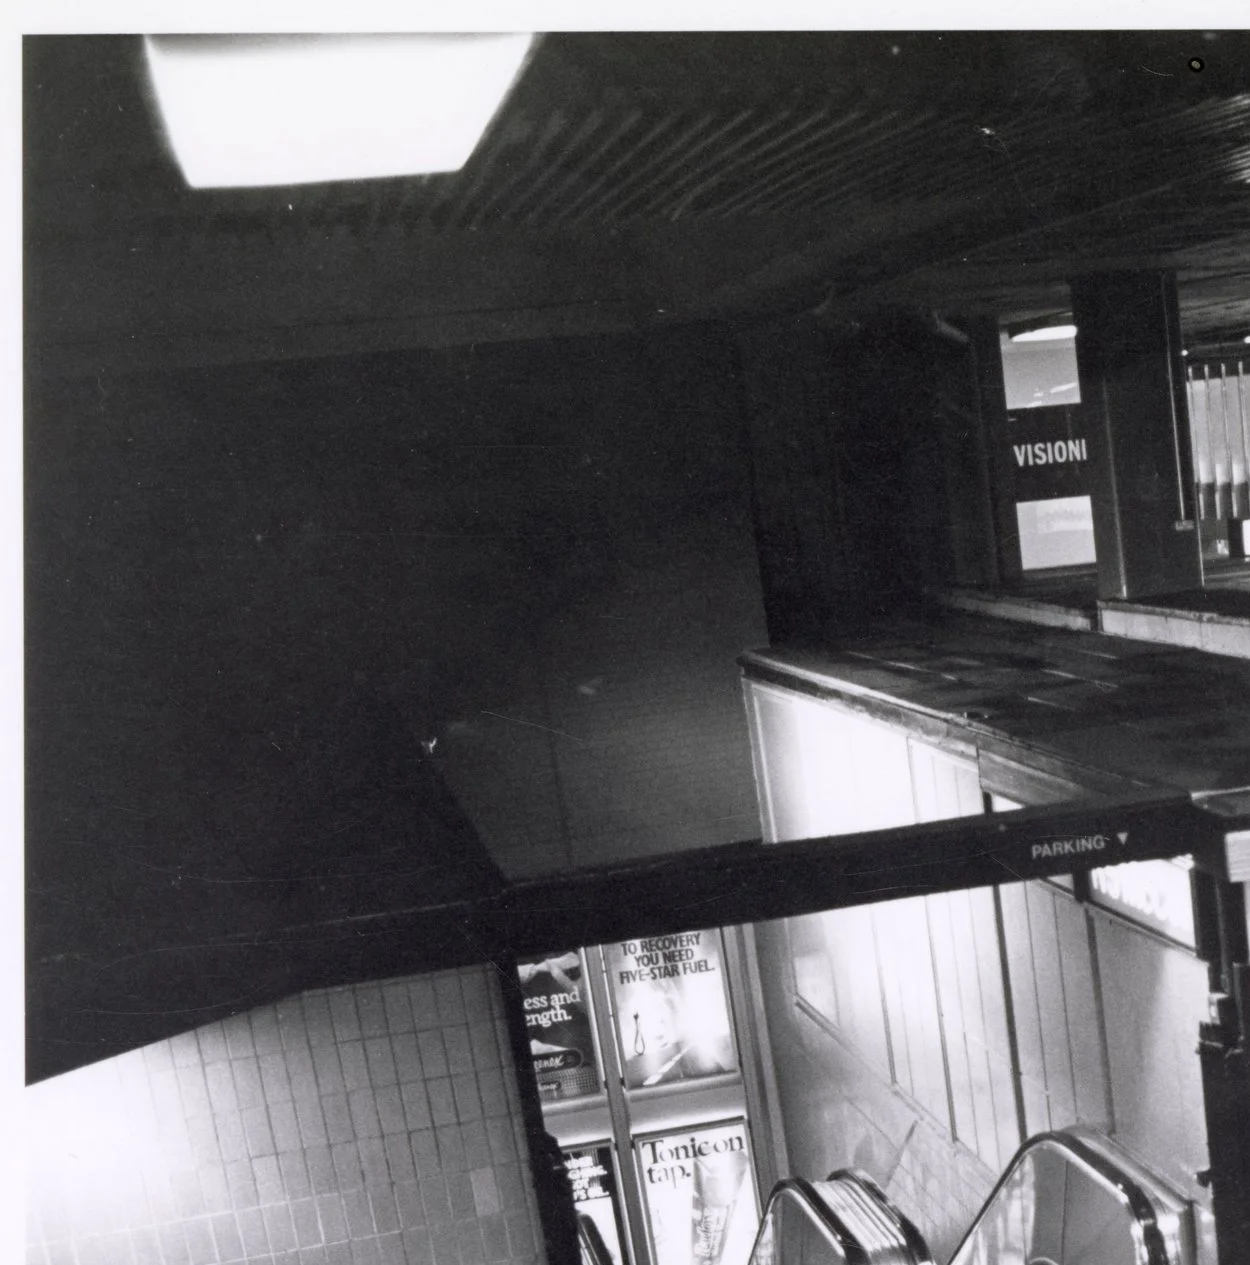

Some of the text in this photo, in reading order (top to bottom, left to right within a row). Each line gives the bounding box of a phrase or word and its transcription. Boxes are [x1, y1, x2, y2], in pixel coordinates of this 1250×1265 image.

[1012, 438, 1088, 468] VISION
[1032, 834, 1106, 860] PARKING
[621, 932, 702, 957] TO RECOVERY
[634, 948, 695, 968] YOU NEED
[619, 959, 716, 986] FIVE-STAR FUEL.
[550, 984, 582, 1006] and
[641, 1135, 745, 1164] Tonic on
[646, 1164, 692, 1189] tap.
